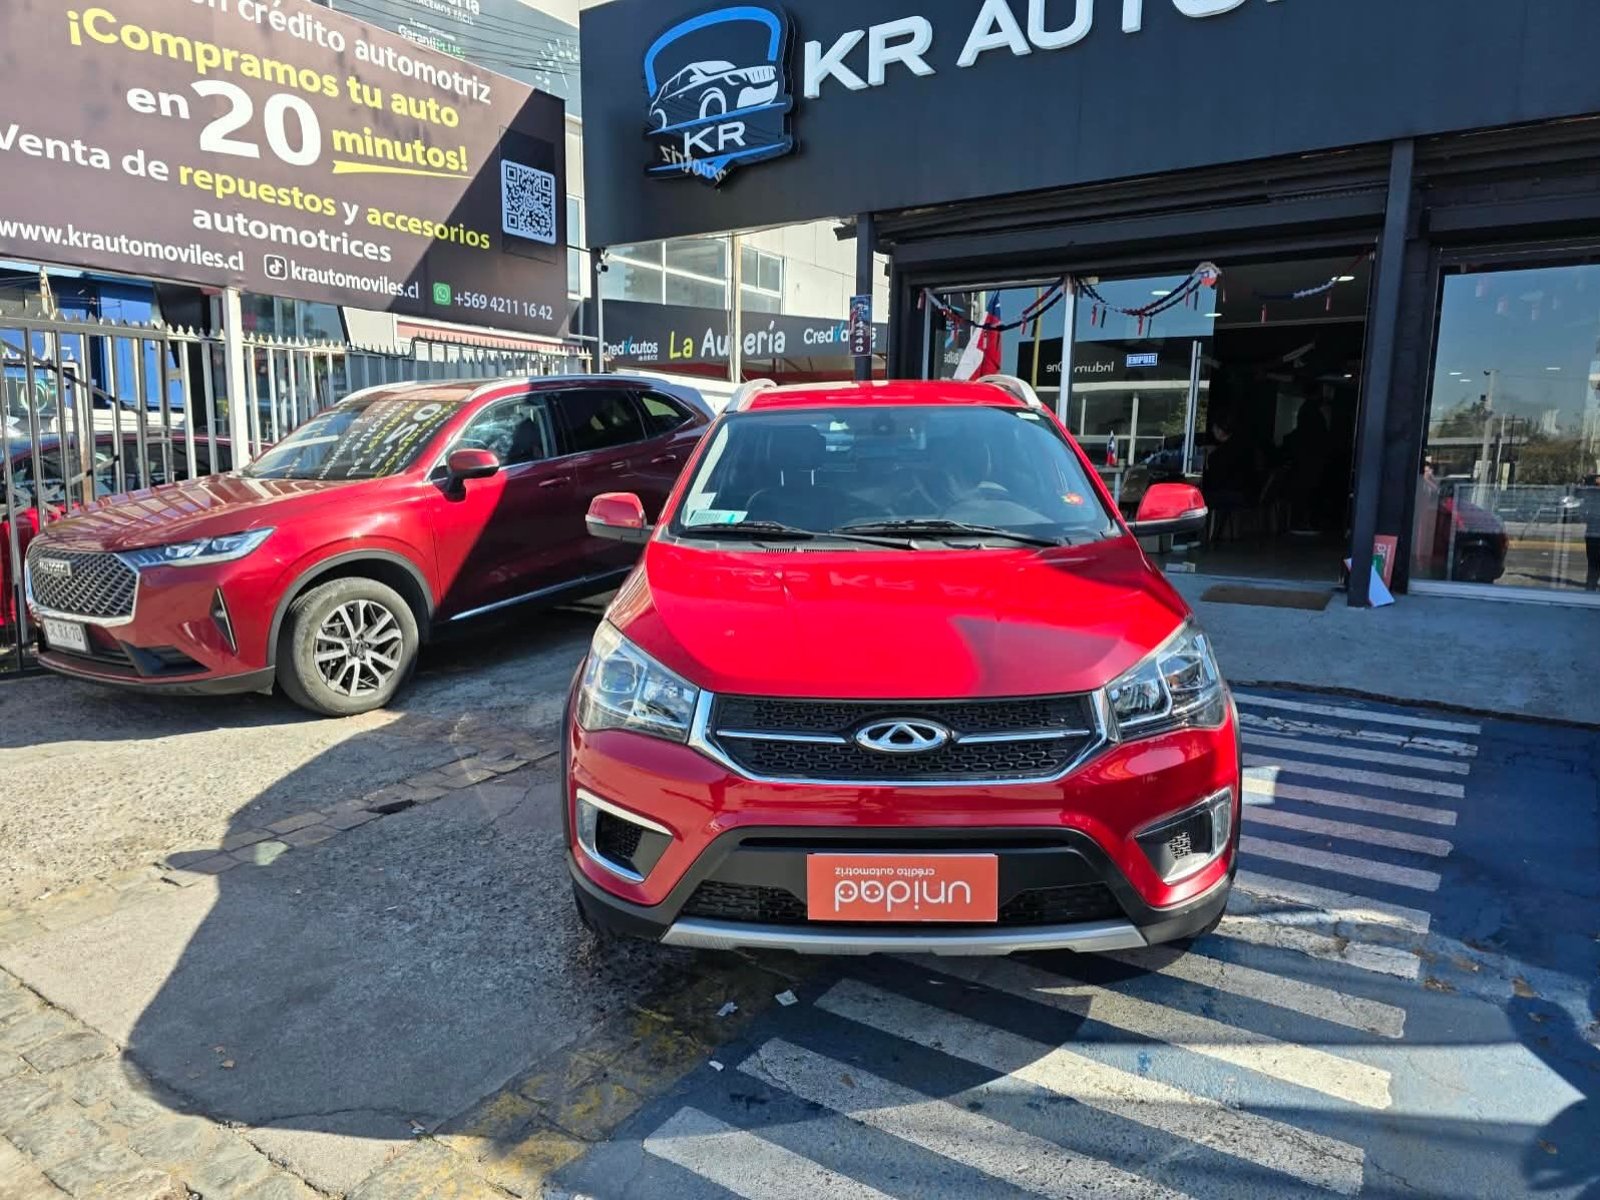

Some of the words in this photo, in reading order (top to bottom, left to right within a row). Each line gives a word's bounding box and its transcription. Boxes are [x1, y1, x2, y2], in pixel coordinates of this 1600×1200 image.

[66, 7, 339, 98] ¡Compramos
[346, 75, 383, 110] tu
[390, 91, 460, 128] auto
[238, 0, 346, 52] crédito
[354, 38, 492, 105] automotriz
[804, 15, 936, 99] KR
[126, 87, 191, 119] en
[190, 79, 322, 167] 20
[331, 126, 469, 173] minutos!
[684, 121, 747, 158] KR
[0, 123, 111, 170] Venta
[121, 149, 170, 182] de
[178, 164, 337, 217] repuestos
[342, 200, 360, 226] y
[365, 206, 491, 250] accesorios
[0, 219, 245, 272] www.krautomoviles.cl
[290, 259, 420, 300] krautomoviles.cl
[192, 208, 393, 263] automotrices
[454, 291, 487, 310] +569
[489, 296, 518, 315] 4211
[669, 330, 694, 360] La
[701, 321, 786, 359] Auería
[834, 866, 894, 877] automotriz
[834, 880, 971, 912] unidad
[896, 867, 935, 877] crédito
